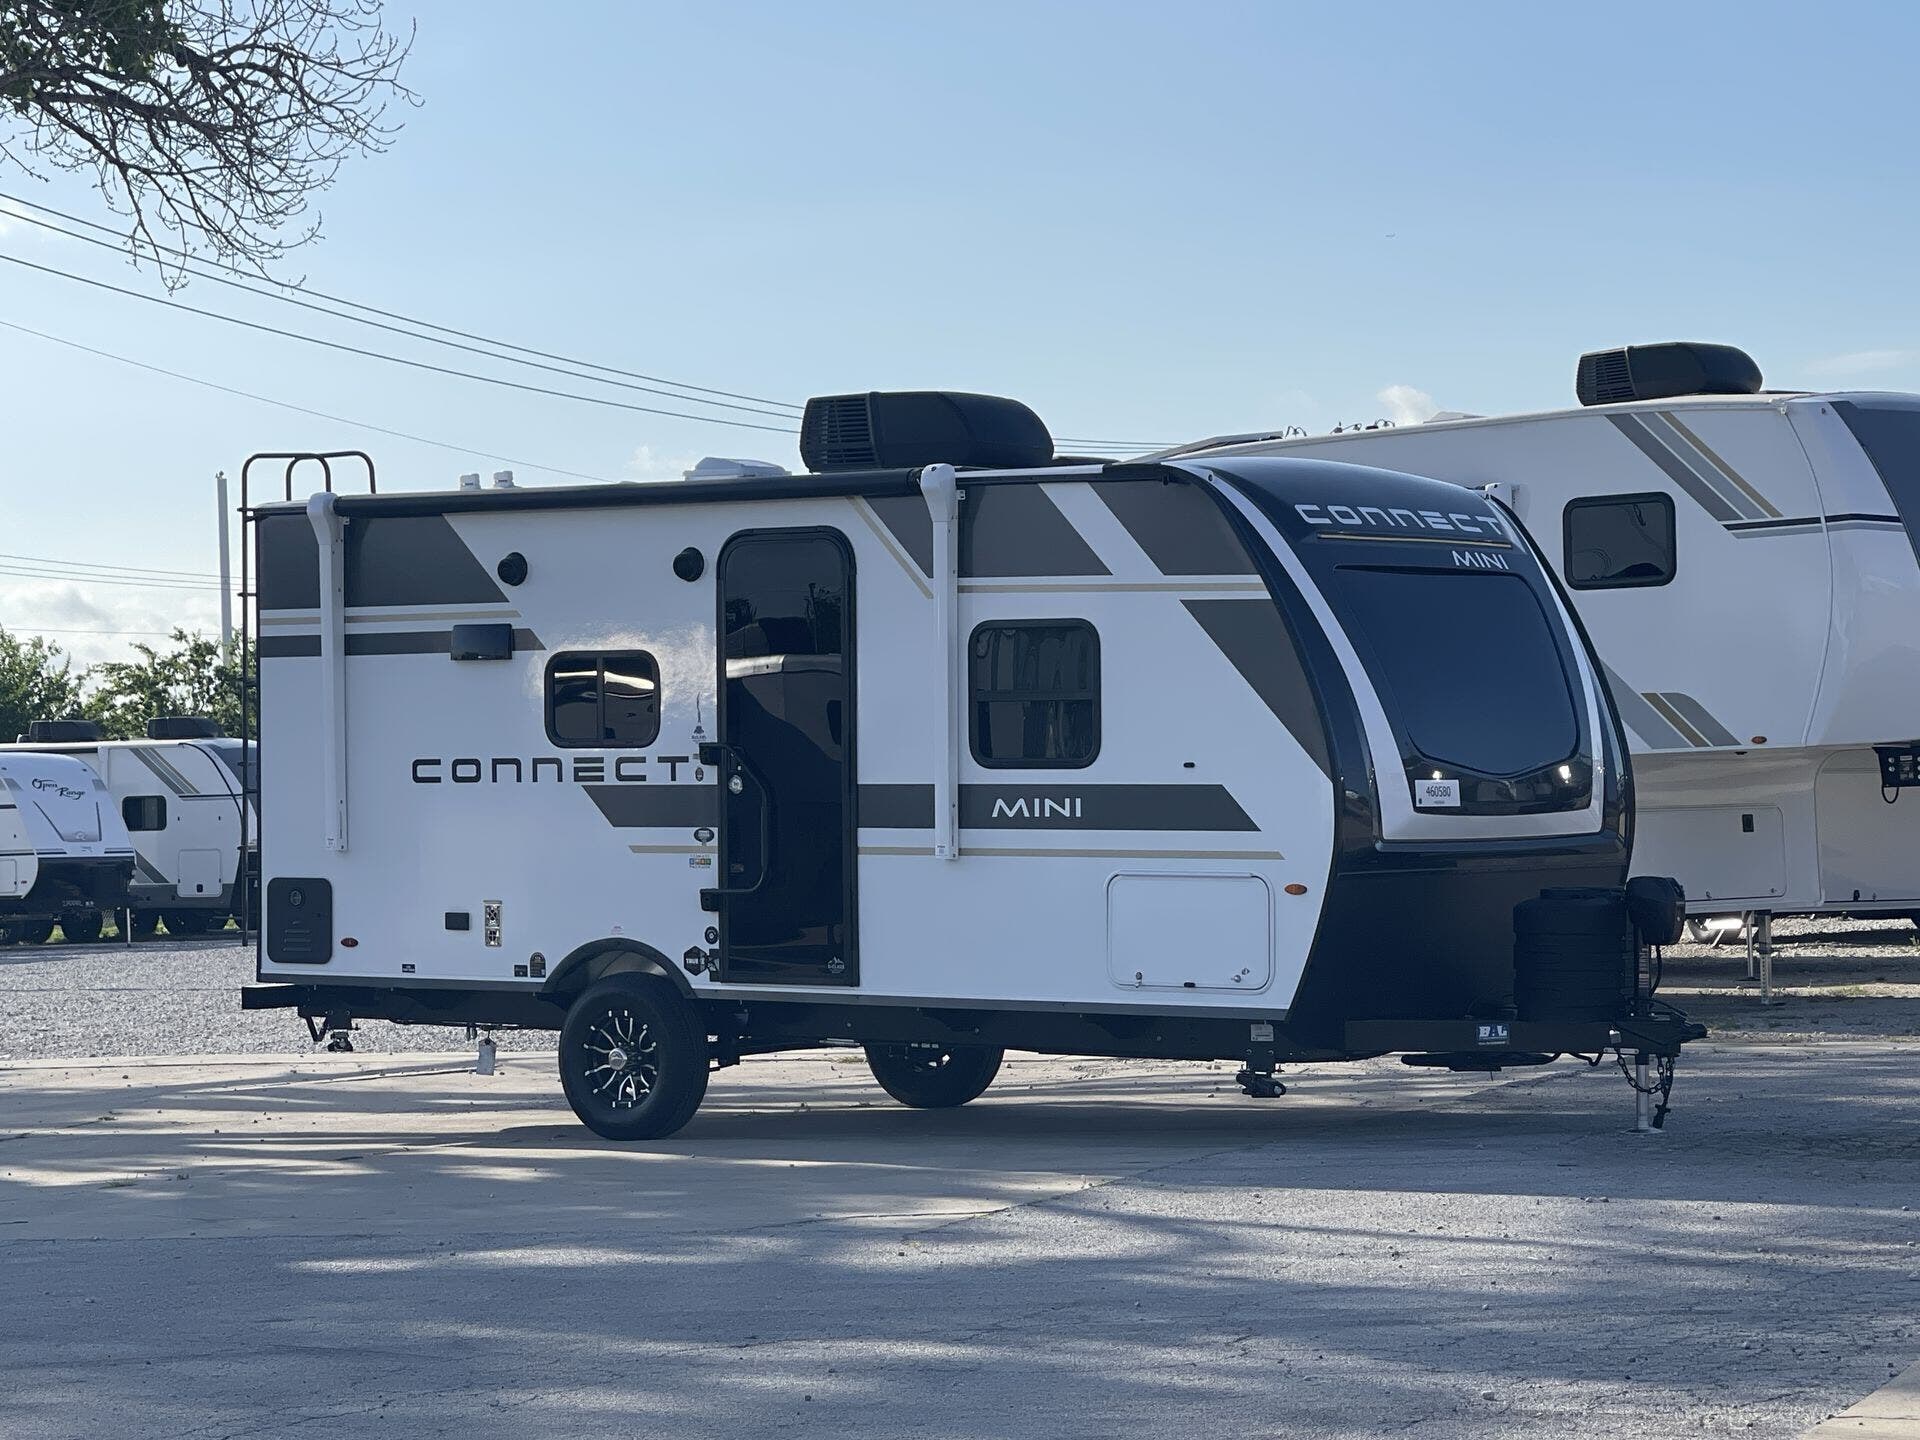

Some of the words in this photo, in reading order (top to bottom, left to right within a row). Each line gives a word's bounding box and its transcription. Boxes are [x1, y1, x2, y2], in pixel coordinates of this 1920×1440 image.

[1295, 504, 1503, 536] CONNECT
[1451, 550, 1510, 570] MINI
[412, 756, 689, 783] CONNECT
[32, 779, 57, 792] Open
[55, 787, 86, 800] Range
[1426, 786, 1451, 797] 460580
[991, 798, 1081, 818] MINI
